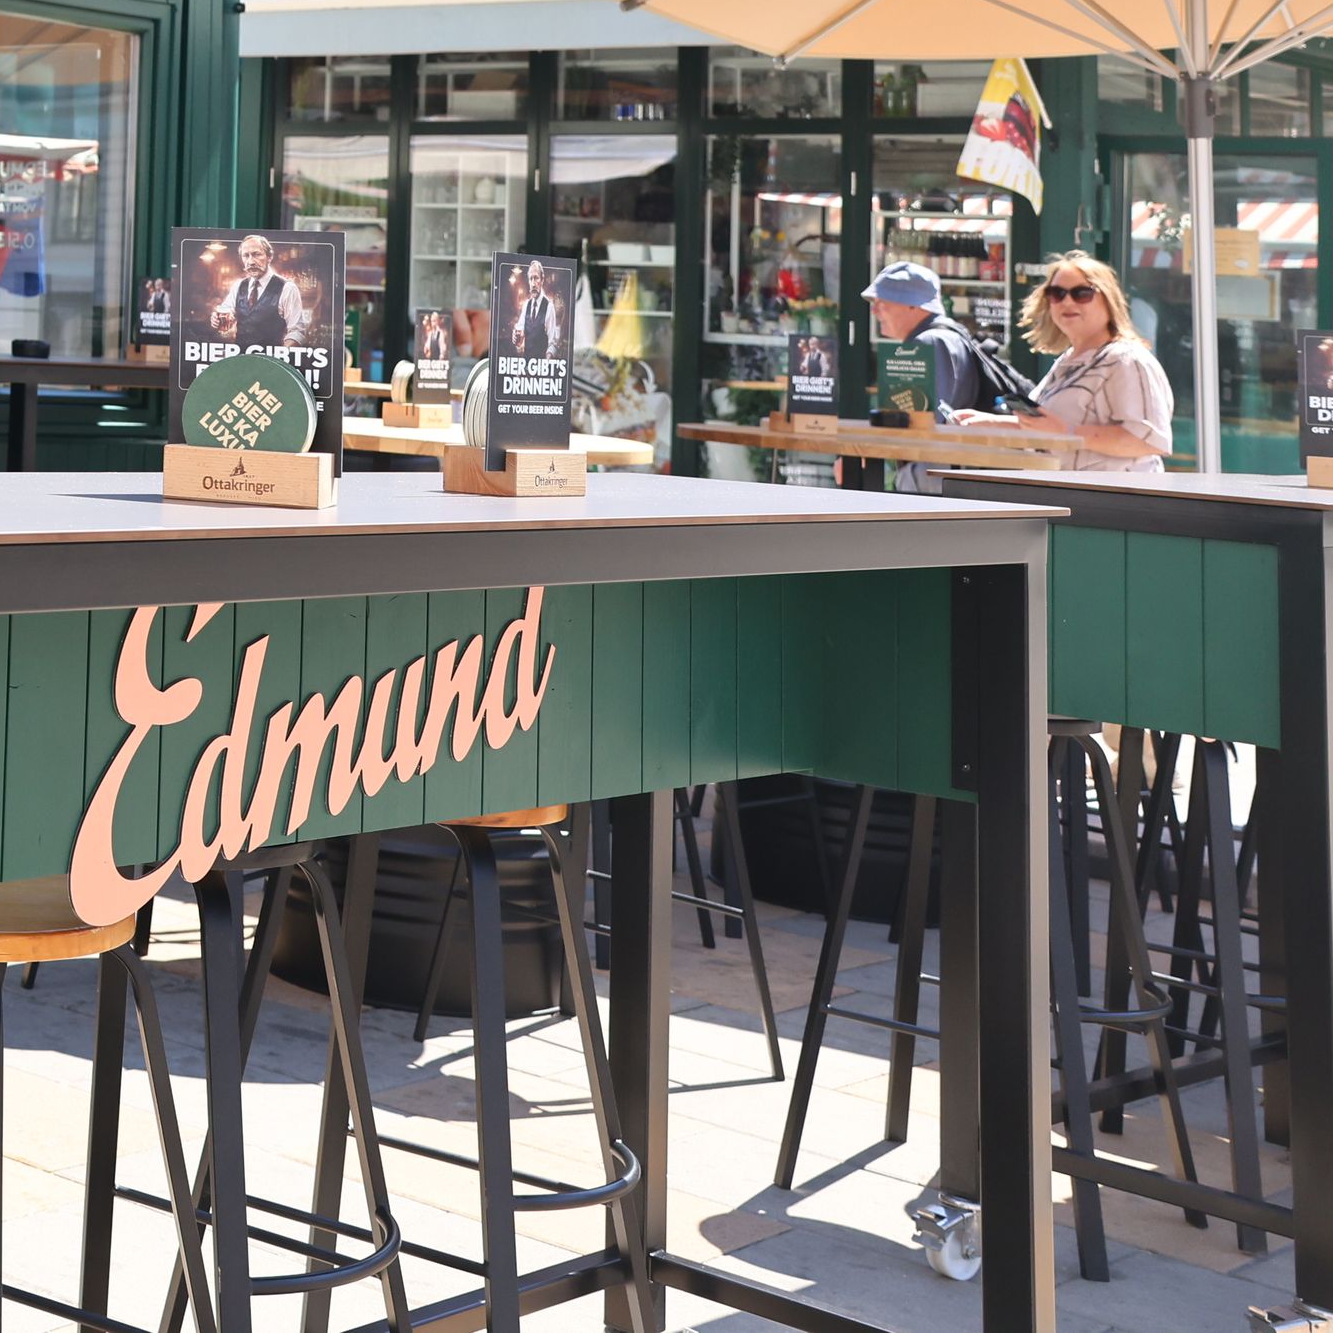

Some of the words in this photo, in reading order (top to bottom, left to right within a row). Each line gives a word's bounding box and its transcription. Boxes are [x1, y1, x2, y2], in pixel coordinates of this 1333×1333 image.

[498, 356, 526, 376] BIER
[527, 358, 567, 377] GIBT'S
[503, 377, 563, 396] DRINNEN!
[247, 381, 283, 415] MEI
[231, 391, 272, 433] BIER
[498, 404, 511, 414] GET
[512, 404, 528, 415] YOUR
[528, 405, 544, 415] BEER
[544, 406, 564, 415] INSIDE
[217, 403, 238, 424] IS
[233, 421, 259, 448] KA
[203, 476, 276, 496] Ottakringer
[534, 475, 568, 488] Ottakringer
[69, 586, 556, 927] Edmund
